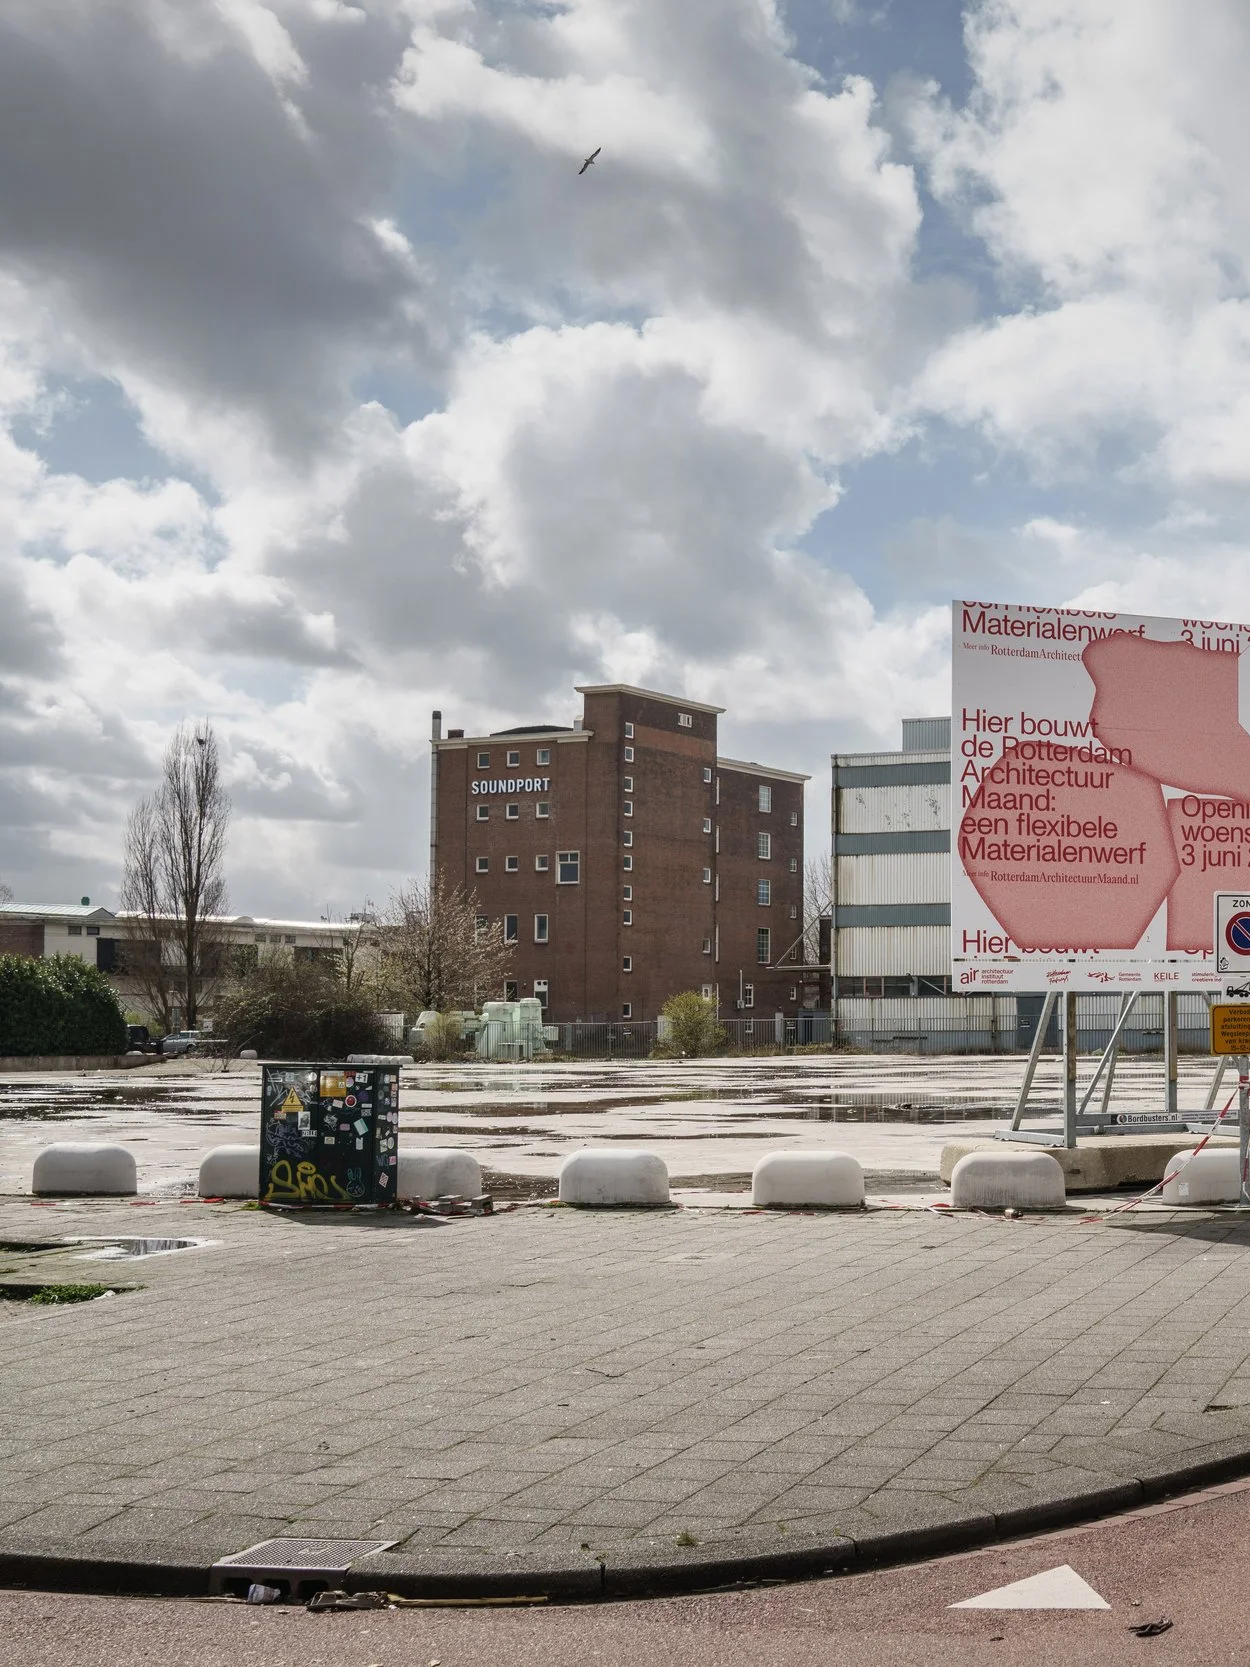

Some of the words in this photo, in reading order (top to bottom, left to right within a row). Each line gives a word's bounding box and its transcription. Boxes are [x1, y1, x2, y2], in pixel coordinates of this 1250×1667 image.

[963, 642, 978, 651] Meer
[991, 645, 1083, 661] RotterdamArchitect
[962, 708, 1014, 733] Hier
[1020, 711, 1099, 738] bouwt
[961, 734, 994, 758] de
[1002, 736, 1132, 765] Rotterdam
[471, 777, 550, 795] SOUNDPORT
[960, 760, 1114, 788] Architectuur
[962, 785, 1056, 811] Maand:
[960, 816, 1009, 835] een
[1016, 813, 1118, 839] flexibele
[962, 836, 1146, 865] Materialenwerf
[1181, 844, 1196, 866] 3
[1201, 844, 1241, 872] juni
[990, 871, 1139, 885] RotterdamArchitectuurMaand.nl
[962, 930, 1012, 954] Hier
[960, 968, 979, 984] air
[1153, 972, 1180, 980] KEILE
[1127, 1113, 1178, 1123] Bordbusters.nl
